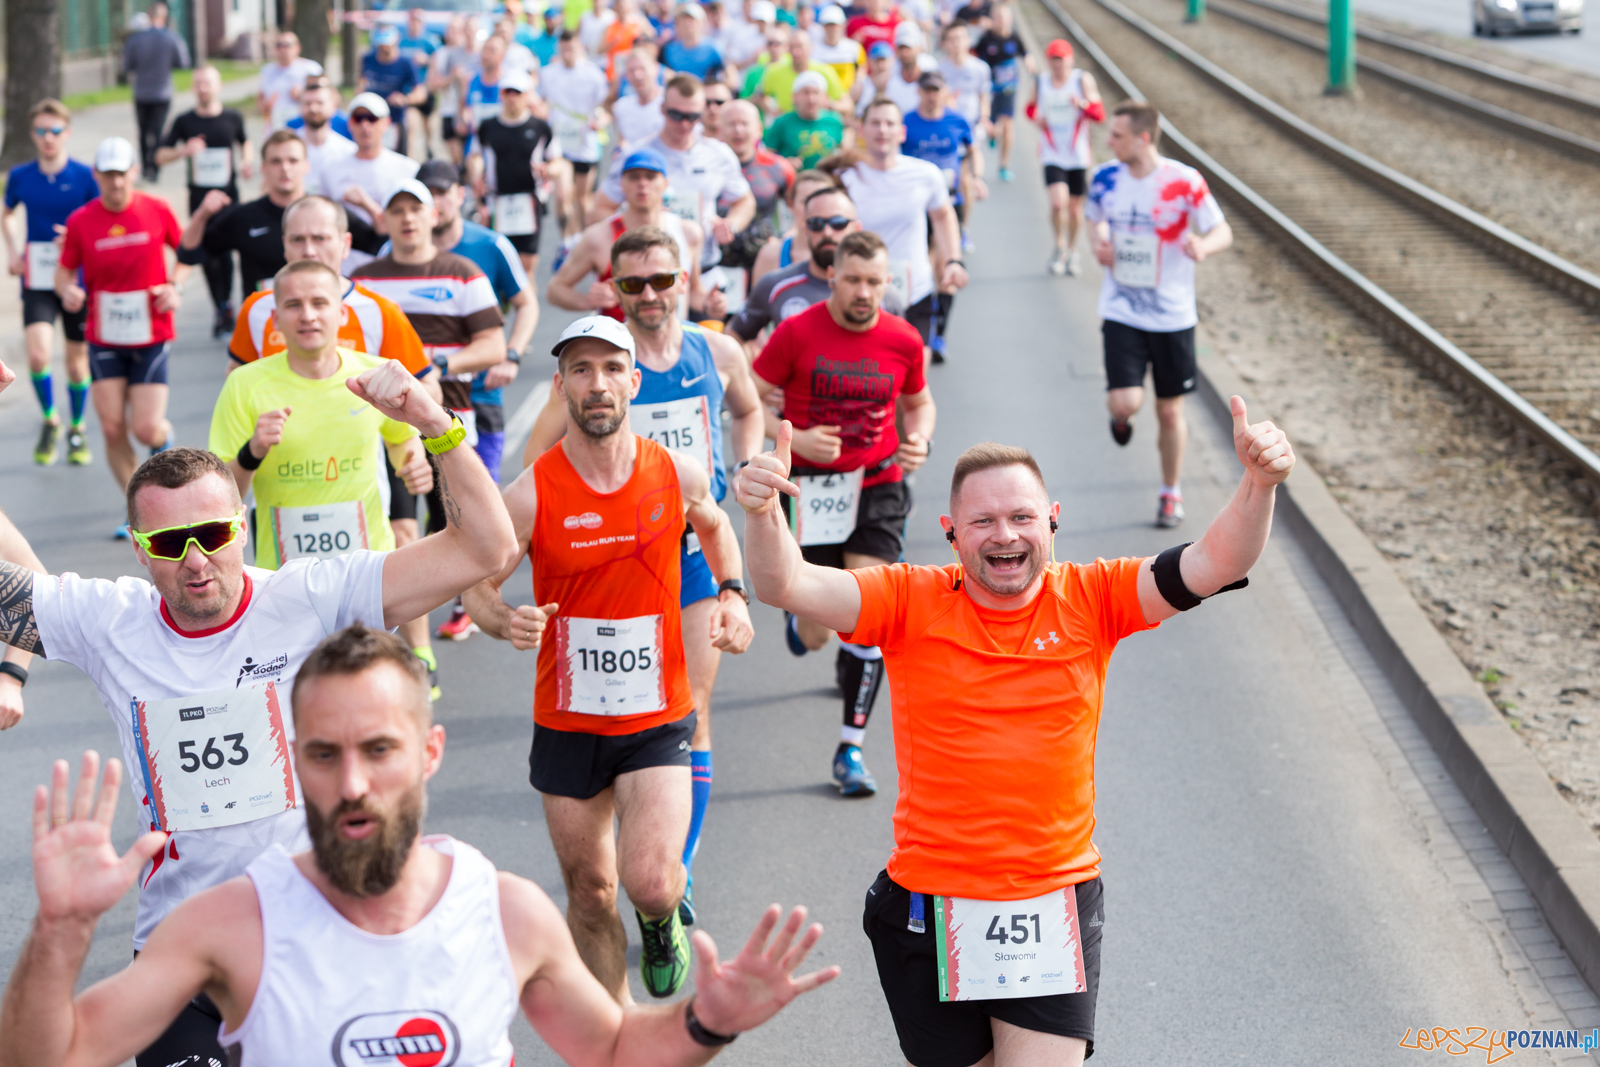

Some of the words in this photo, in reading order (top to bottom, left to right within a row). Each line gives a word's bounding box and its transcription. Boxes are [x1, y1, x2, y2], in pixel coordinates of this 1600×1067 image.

[814, 372, 892, 399] RANKOR
[293, 530, 350, 553] 1280
[599, 536, 616, 545] RUN
[616, 534, 636, 542] TEAM
[577, 646, 652, 673] 11805
[605, 678, 626, 687] Gilles
[178, 732, 249, 773] 563
[204, 776, 231, 788] Lech
[985, 913, 1041, 945] 451
[994, 951, 1037, 962] Sławomir
